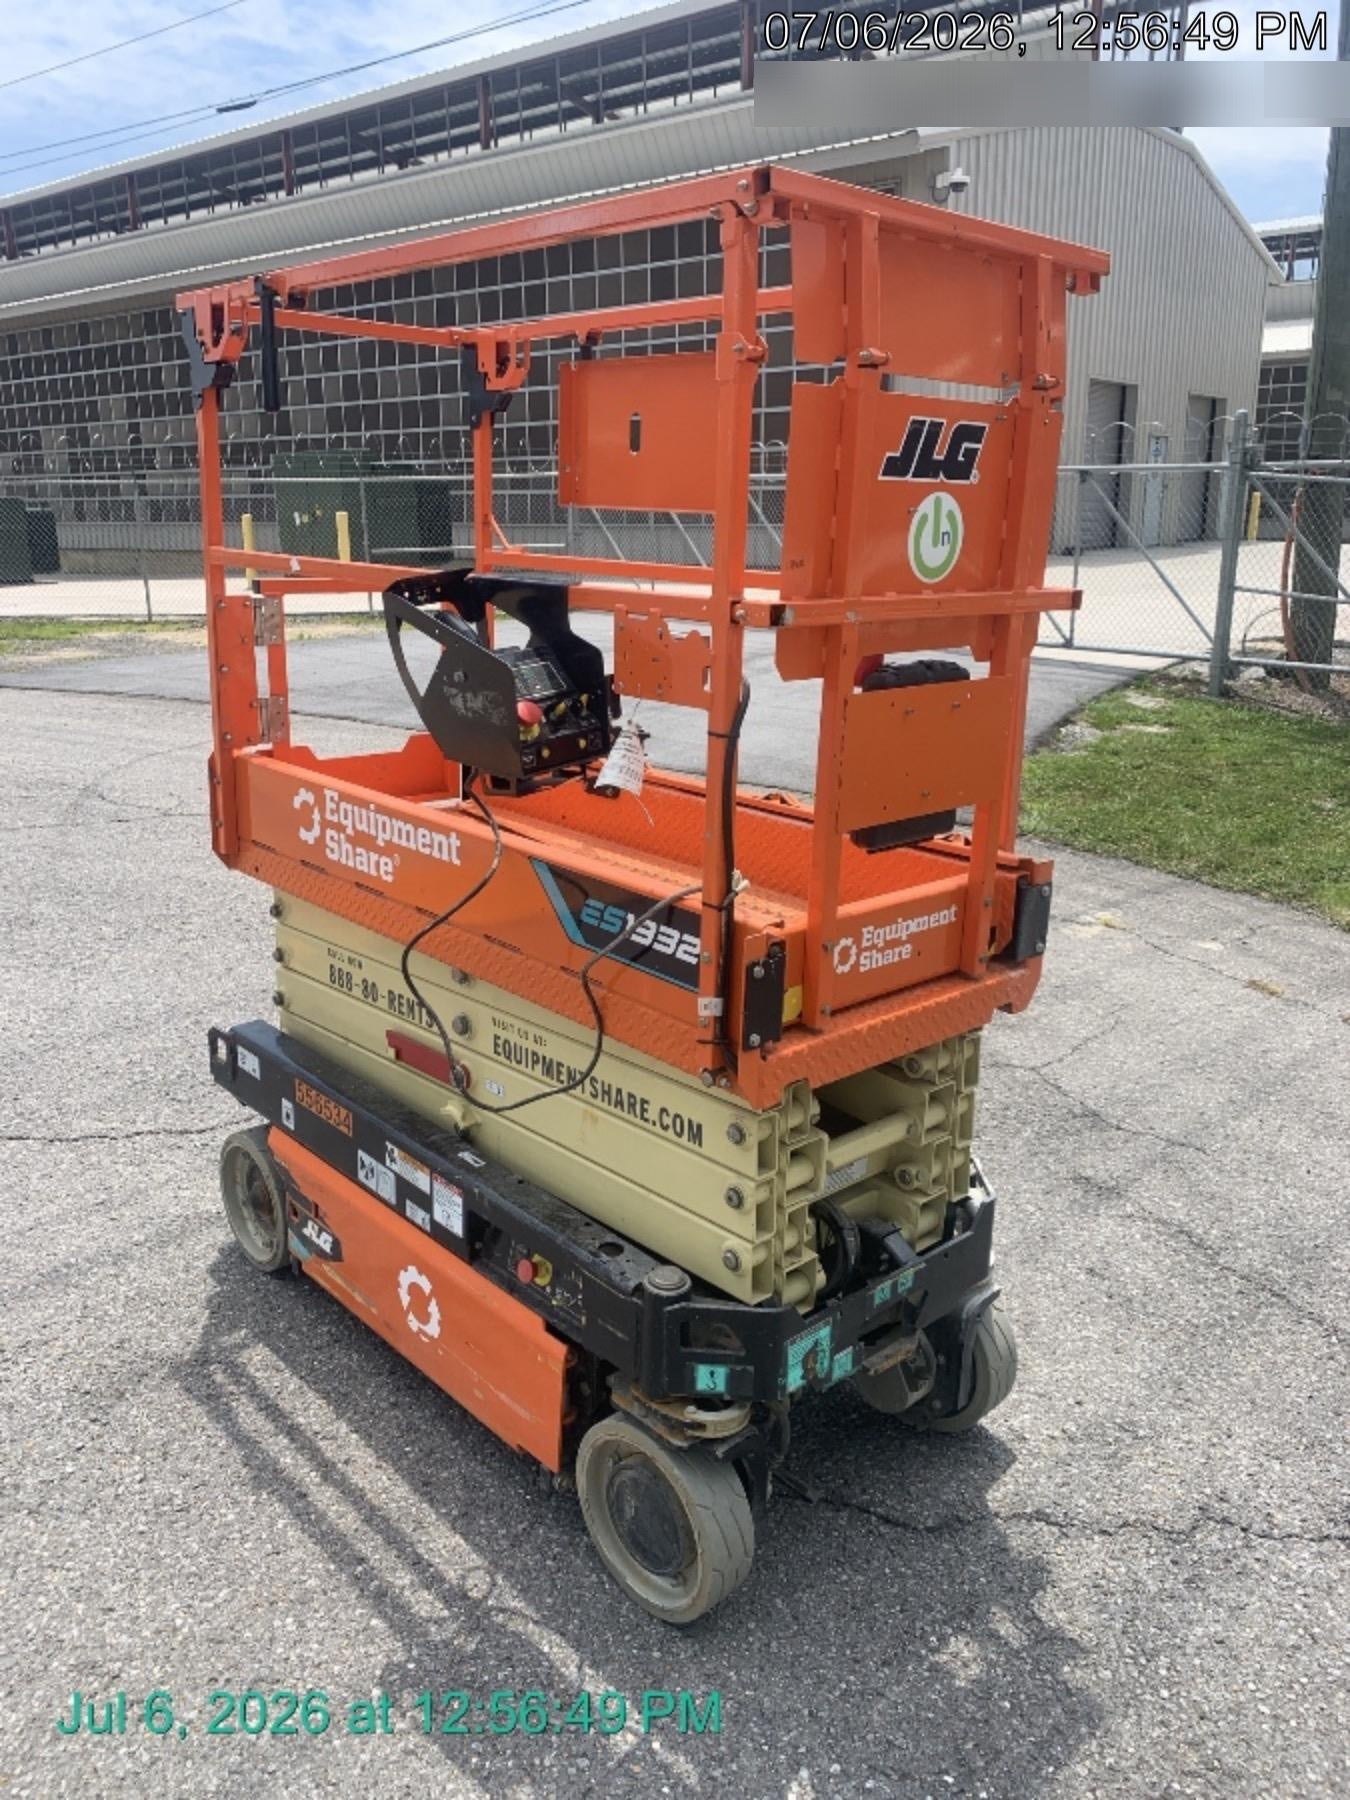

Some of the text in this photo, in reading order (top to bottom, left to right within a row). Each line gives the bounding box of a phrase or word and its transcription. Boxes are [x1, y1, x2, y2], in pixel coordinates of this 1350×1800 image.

[878, 416, 988, 484] JLG
[324, 789, 461, 866] Equipment
[859, 943, 913, 973] Share
[861, 904, 958, 948] Equipment
[493, 1034, 703, 1148] EQUIPMENTSHARE.COM
